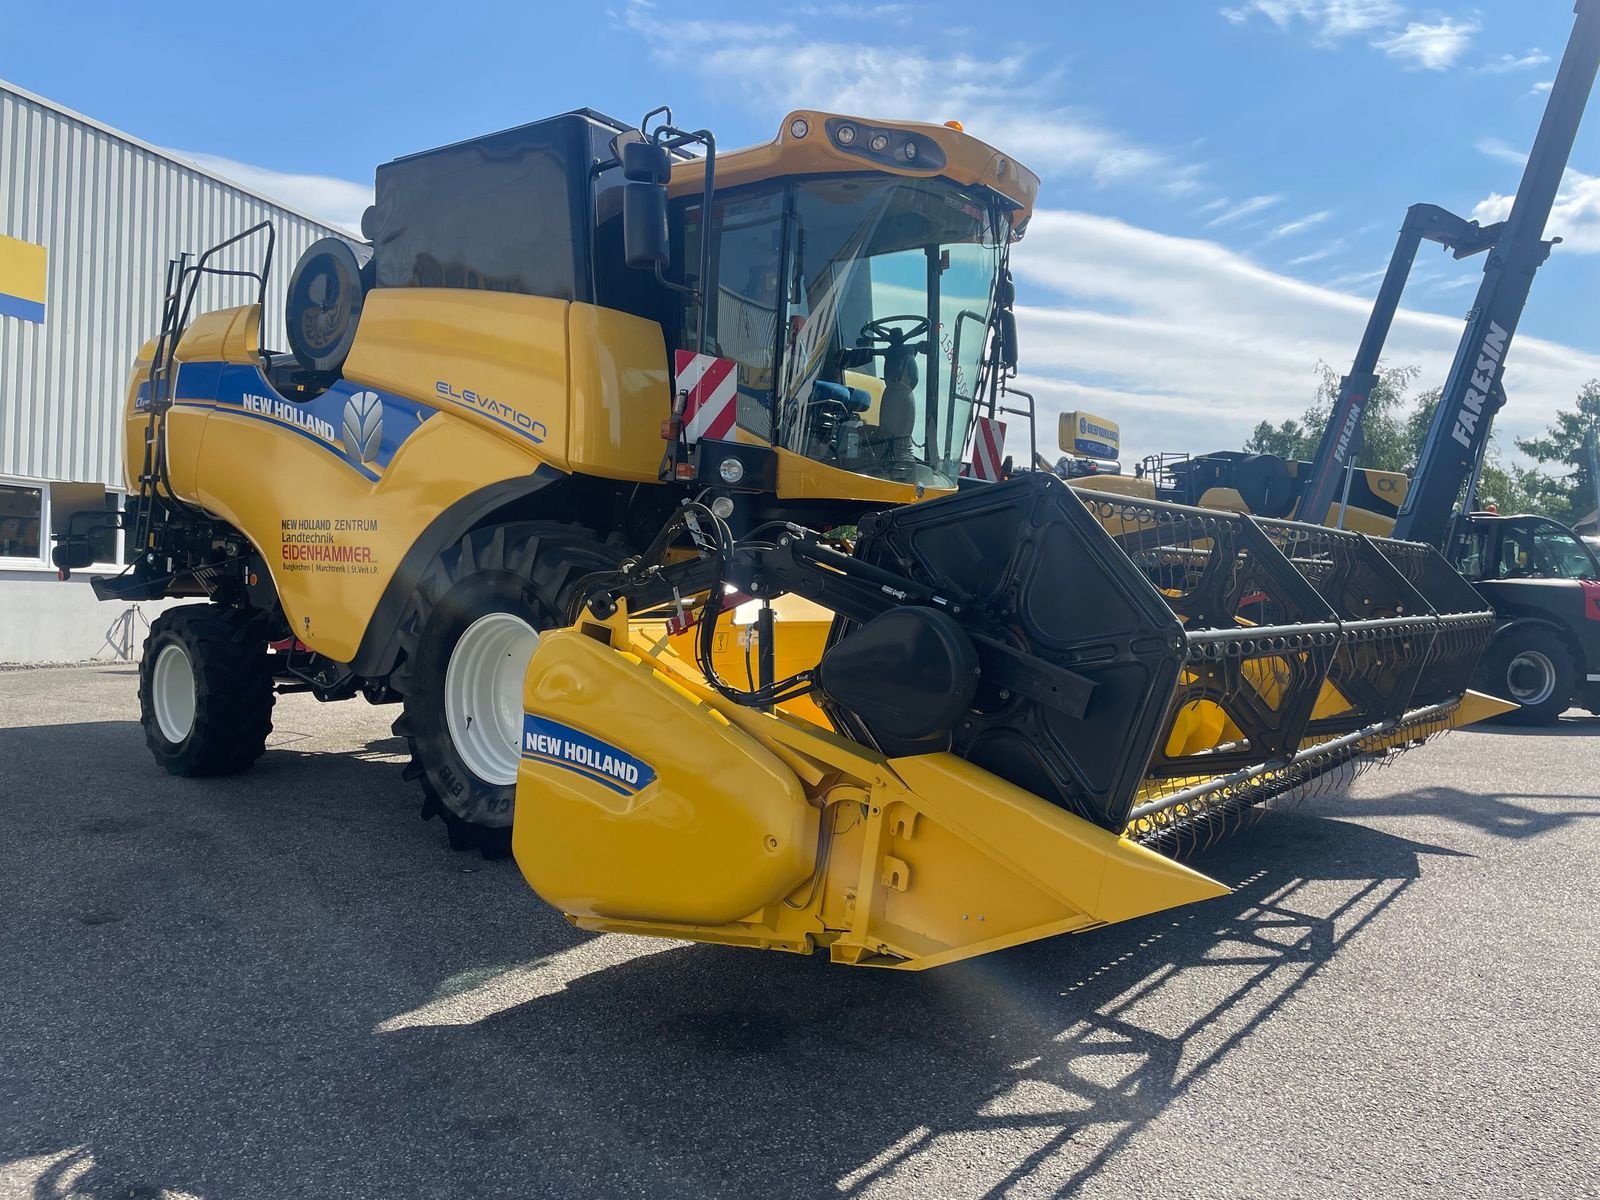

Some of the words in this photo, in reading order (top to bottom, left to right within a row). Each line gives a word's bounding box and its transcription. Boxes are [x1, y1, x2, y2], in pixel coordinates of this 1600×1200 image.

[1451, 319, 1509, 449] FARESIN
[242, 392, 273, 415] NEW
[274, 400, 335, 442] HOLLAND
[435, 381, 547, 438] ELEVATION
[1333, 402, 1361, 463] FARESIN
[1376, 478, 1398, 494] CX
[281, 519, 297, 531] NEW
[298, 519, 331, 531] HOLLAND
[334, 519, 378, 532] ZENTRUM
[281, 531, 335, 544] Landtechnik
[281, 544, 371, 563] EIDENHAMMER
[525, 731, 562, 757] NEW
[563, 740, 639, 785] HOLLAND
